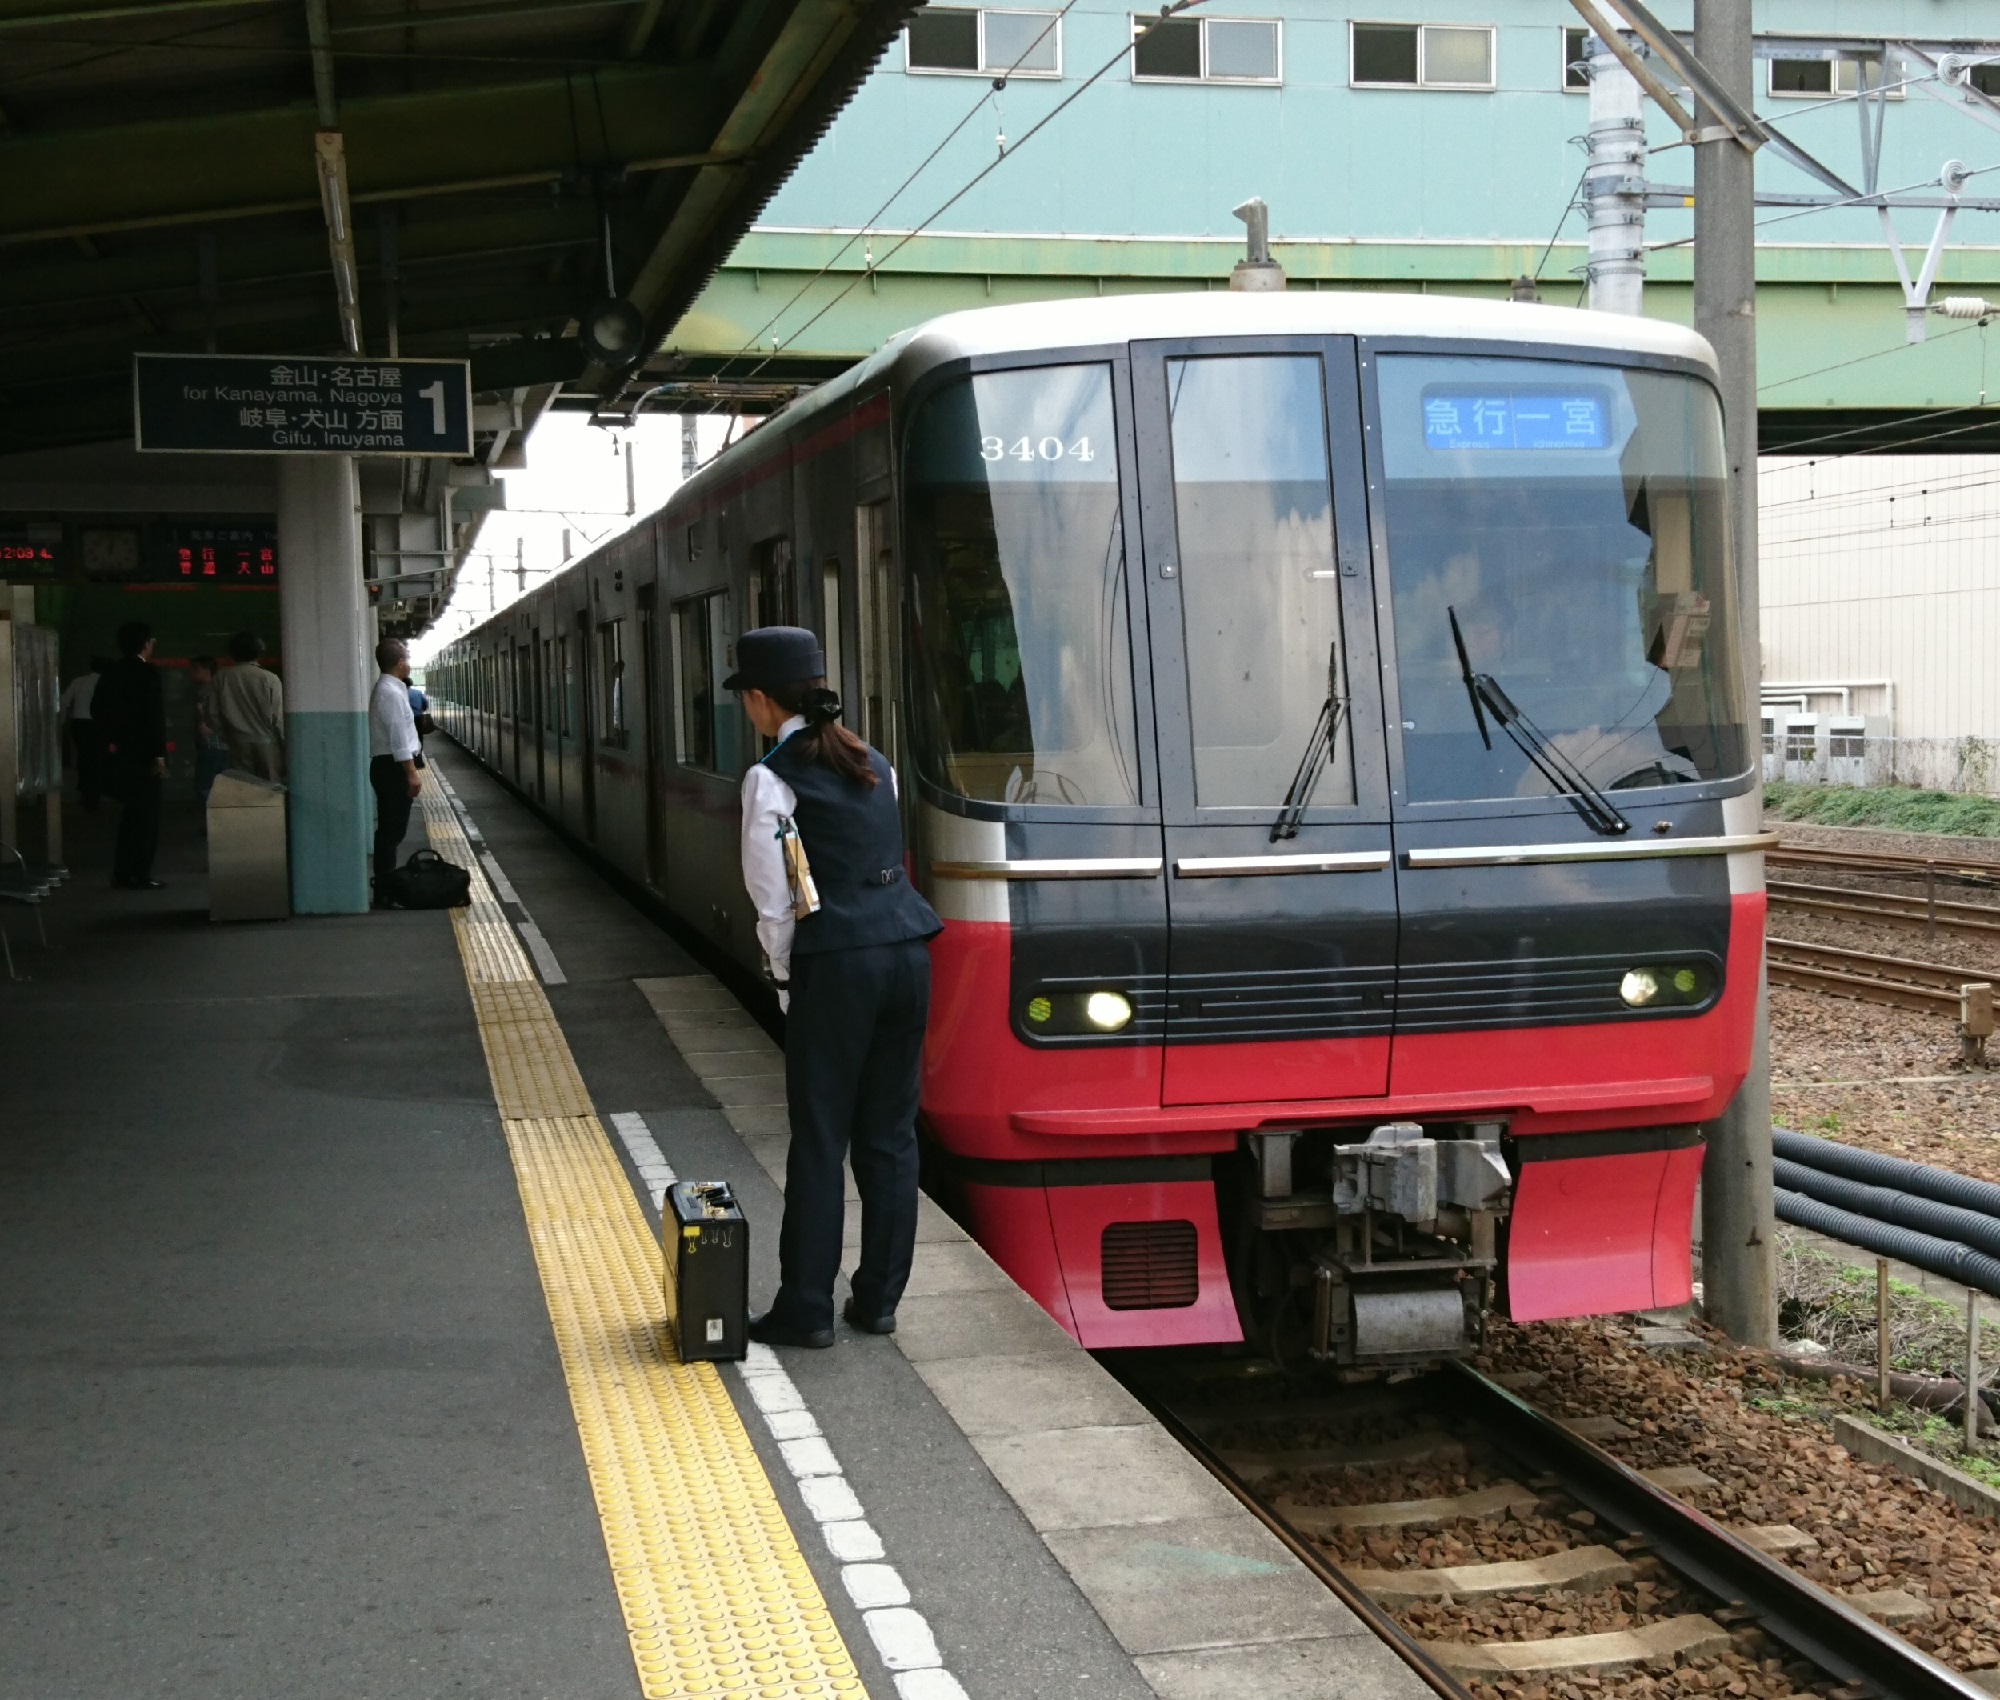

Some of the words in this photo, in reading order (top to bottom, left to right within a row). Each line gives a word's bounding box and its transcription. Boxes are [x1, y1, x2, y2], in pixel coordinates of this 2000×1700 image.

[269, 364, 402, 388] 金山・名古屋
[183, 385, 208, 401] for
[214, 386, 323, 405] Kanayama,
[329, 388, 403, 407] Nagoya
[418, 380, 447, 435] 1
[239, 406, 348, 430] 岐阜・犬山
[356, 409, 403, 431] 方面
[1425, 399, 1507, 435] 急行
[1516, 399, 1596, 435] 一宮
[271, 430, 317, 447] Gifu,
[323, 431, 405, 449] Inuyama
[980, 436, 1095, 463] 3404
[1449, 439, 1490, 449] Express
